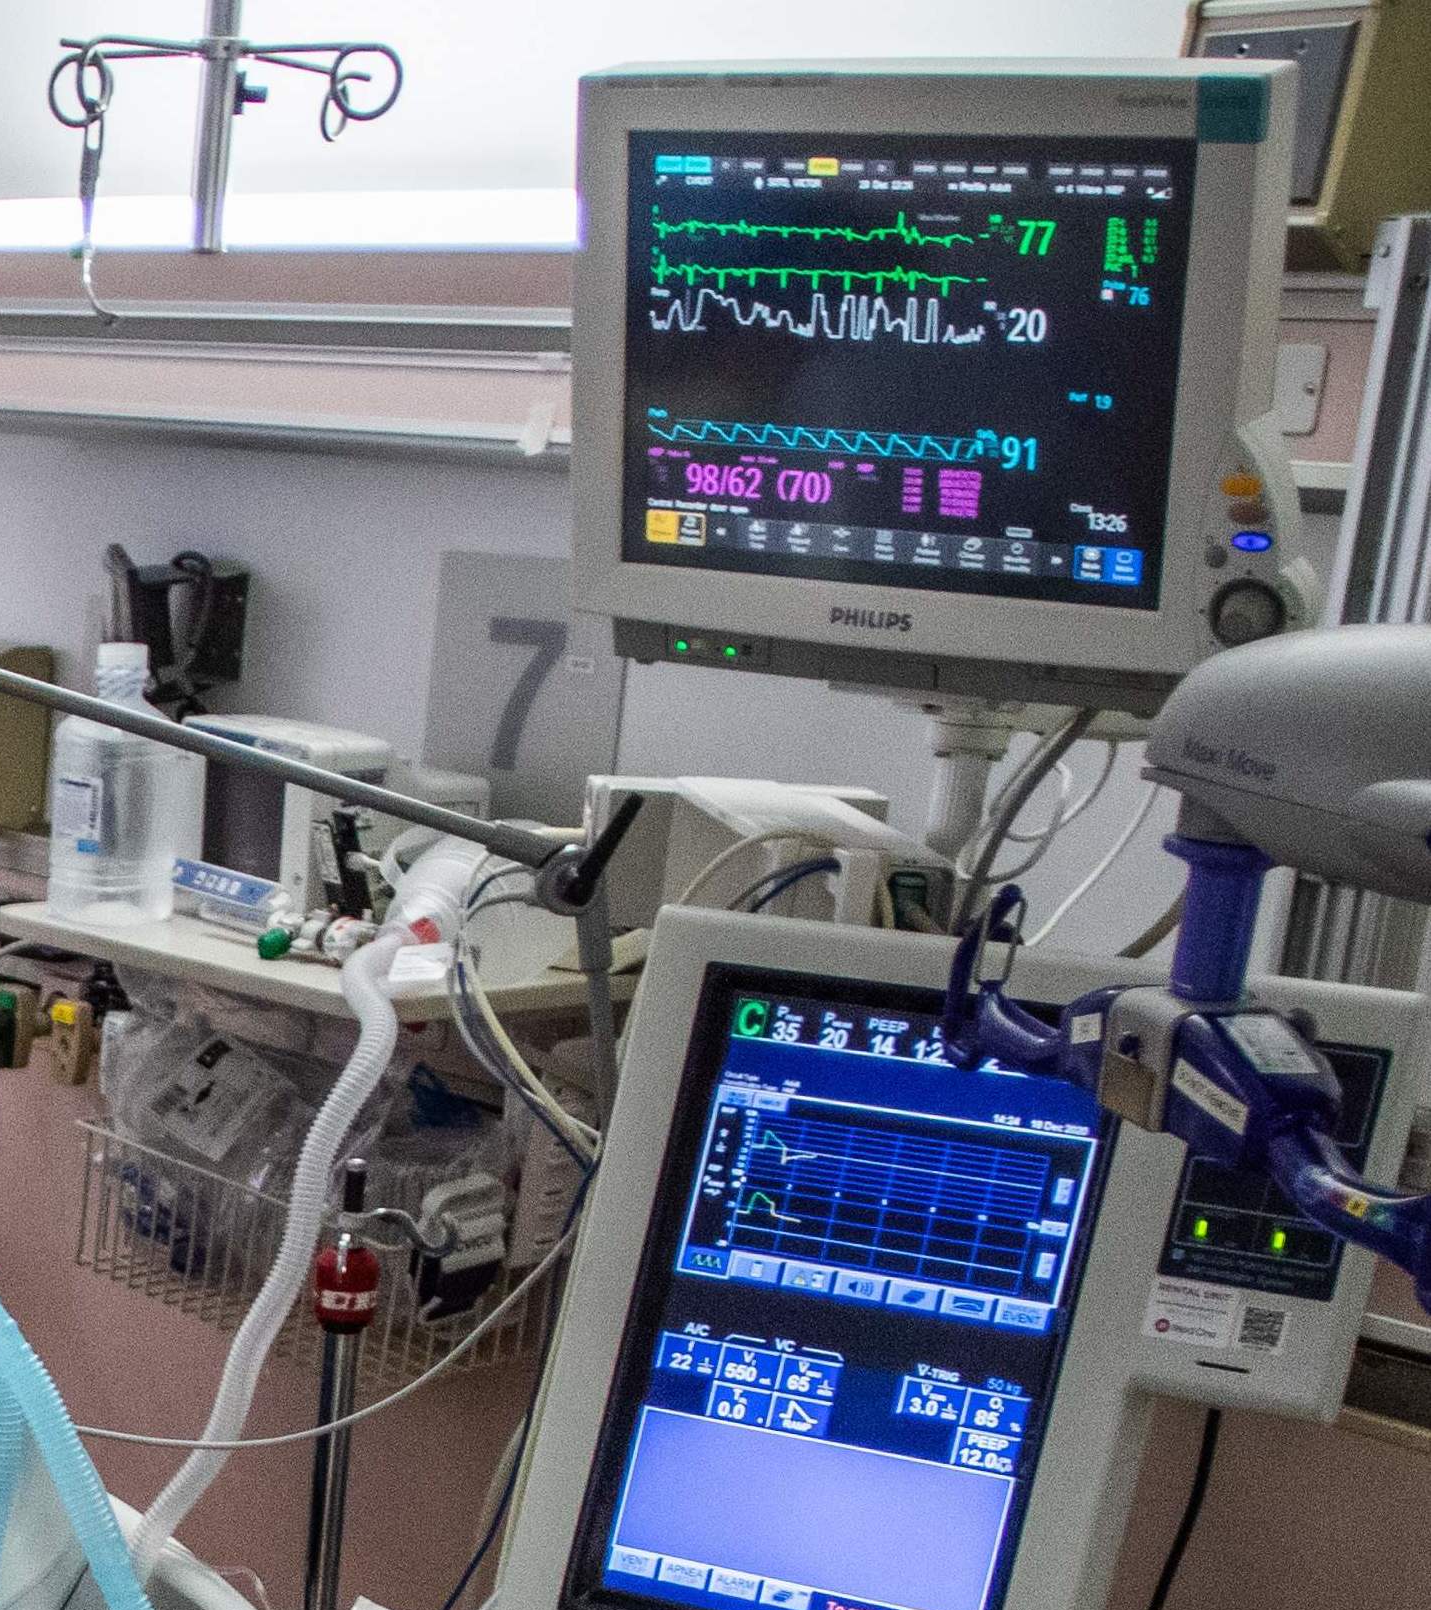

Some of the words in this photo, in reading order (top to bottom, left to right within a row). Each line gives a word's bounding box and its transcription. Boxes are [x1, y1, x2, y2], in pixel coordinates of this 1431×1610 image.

[1016, 219, 1057, 256] 77
[1128, 285, 1151, 306] 76
[1006, 307, 1048, 343] 20
[1000, 435, 1038, 471] 91
[685, 462, 763, 499] 98/62
[776, 469, 833, 503] (70)
[1087, 512, 1128, 533] 13:26
[829, 605, 914, 632] PHILIPS
[489, 615, 568, 771] 7
[737, 1001, 766, 1036] C
[867, 1016, 909, 1034] PEEP
[770, 1021, 799, 1043] 35
[818, 1027, 849, 1050] 20
[869, 1034, 897, 1056] 14
[1001, 1309, 1043, 1326] EVENT
[684, 1321, 712, 1337] A/C
[774, 1337, 797, 1353] VC
[668, 1352, 694, 1371] 22
[724, 1362, 758, 1382] 550
[786, 1374, 811, 1392] 65
[716, 1400, 746, 1420] 0.0
[908, 1396, 939, 1417] 3.0
[973, 1409, 1000, 1428] 85
[967, 1433, 1010, 1451] PEEP
[959, 1447, 998, 1470] 12.0
[620, 1552, 650, 1567] VENT
[666, 1562, 704, 1578] APNEA
[716, 1573, 756, 1589] ALARM
